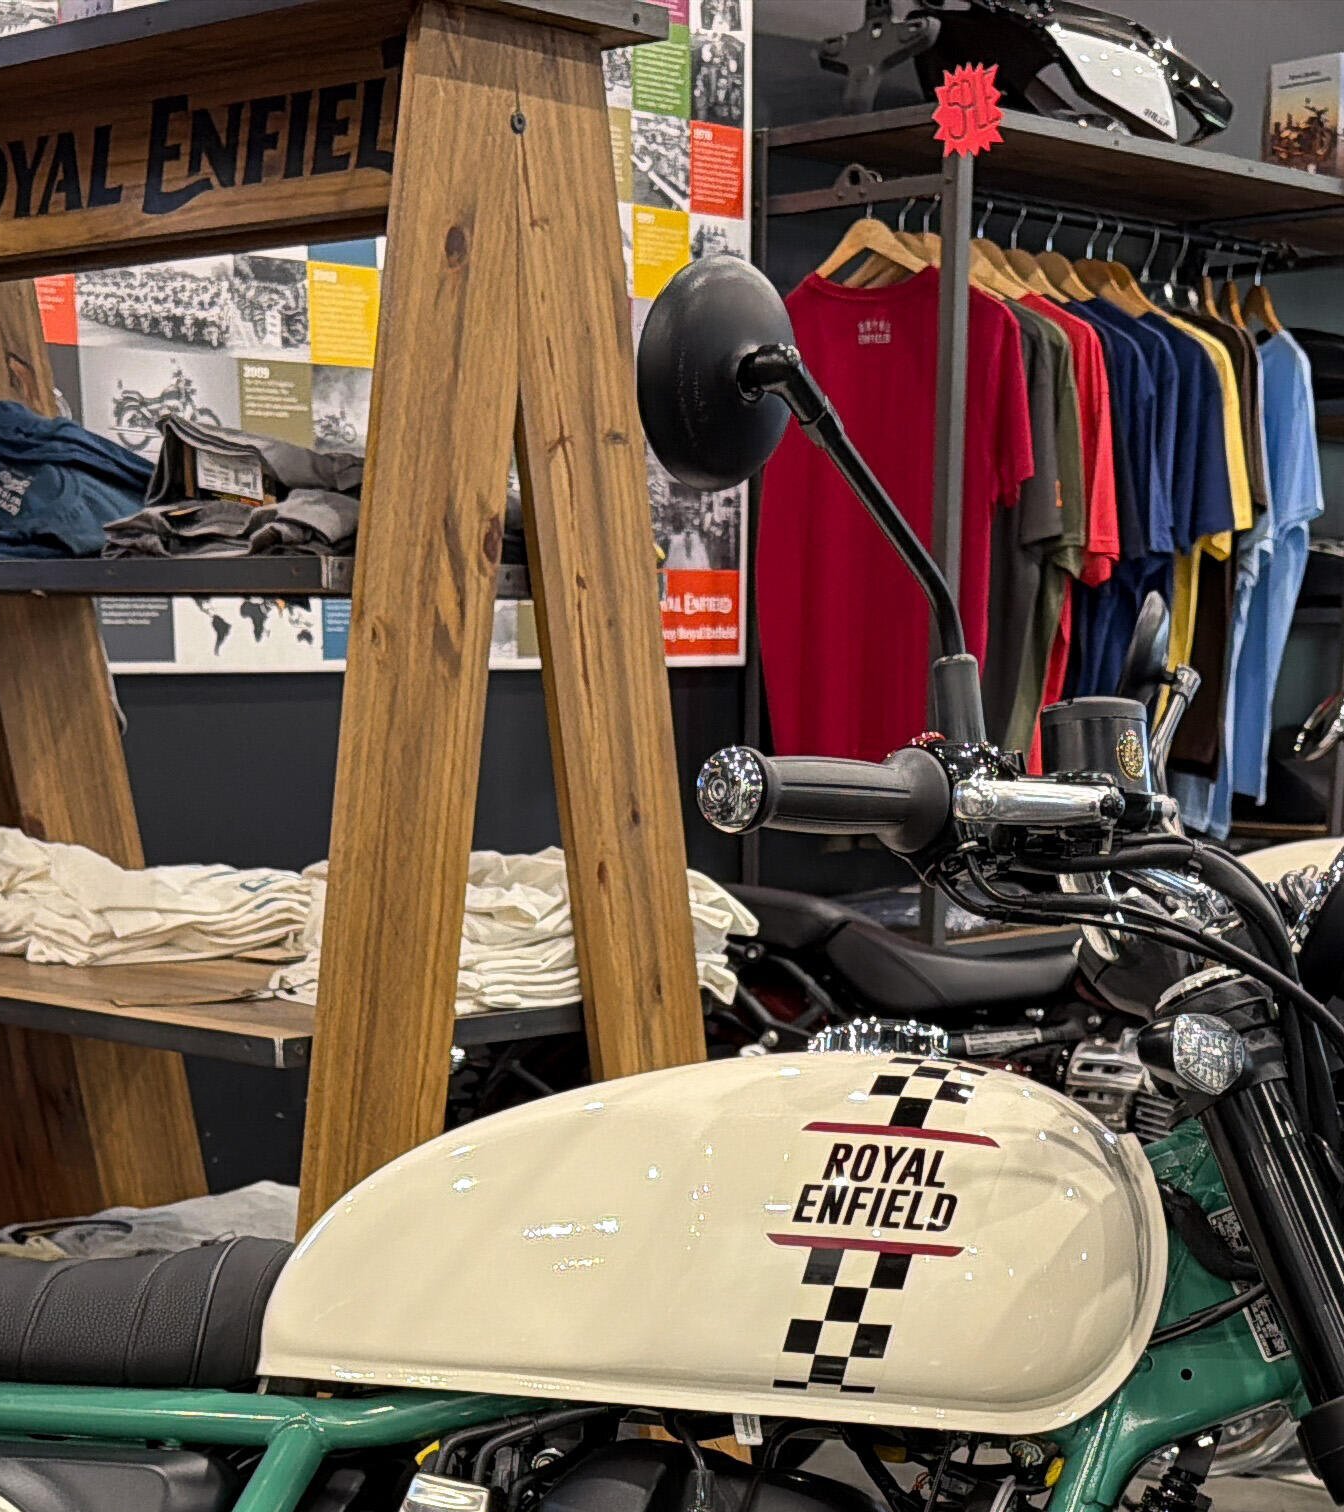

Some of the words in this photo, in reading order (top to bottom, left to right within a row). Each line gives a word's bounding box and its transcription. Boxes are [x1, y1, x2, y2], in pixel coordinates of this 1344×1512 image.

[142, 45, 402, 214] ENFIEL
[822, 1143, 945, 1188] ROYAL
[792, 1184, 958, 1232] ENFIELD
